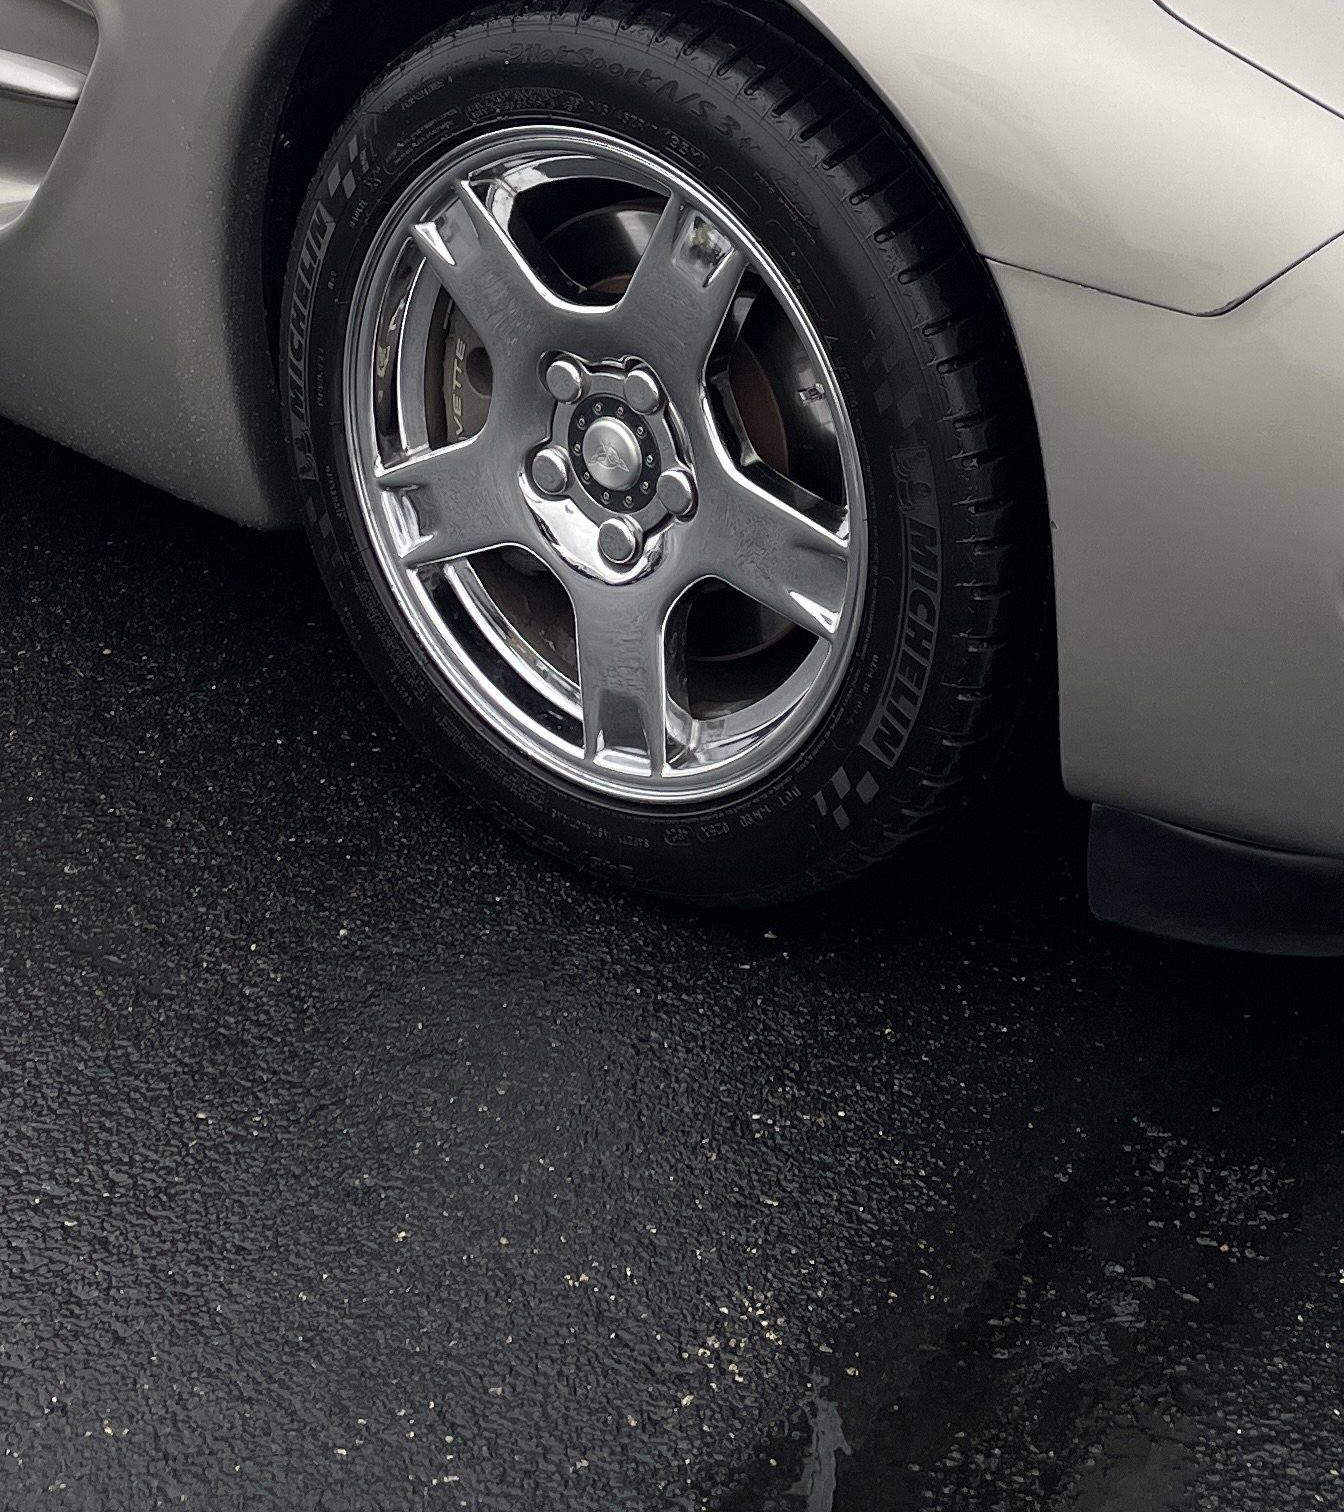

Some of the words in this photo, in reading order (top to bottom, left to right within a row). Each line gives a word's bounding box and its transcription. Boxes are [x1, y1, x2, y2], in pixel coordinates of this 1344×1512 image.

[289, 203, 329, 423] MICHELIN
[452, 337, 467, 440] VETTE
[872, 517, 939, 761] MICHELIN
